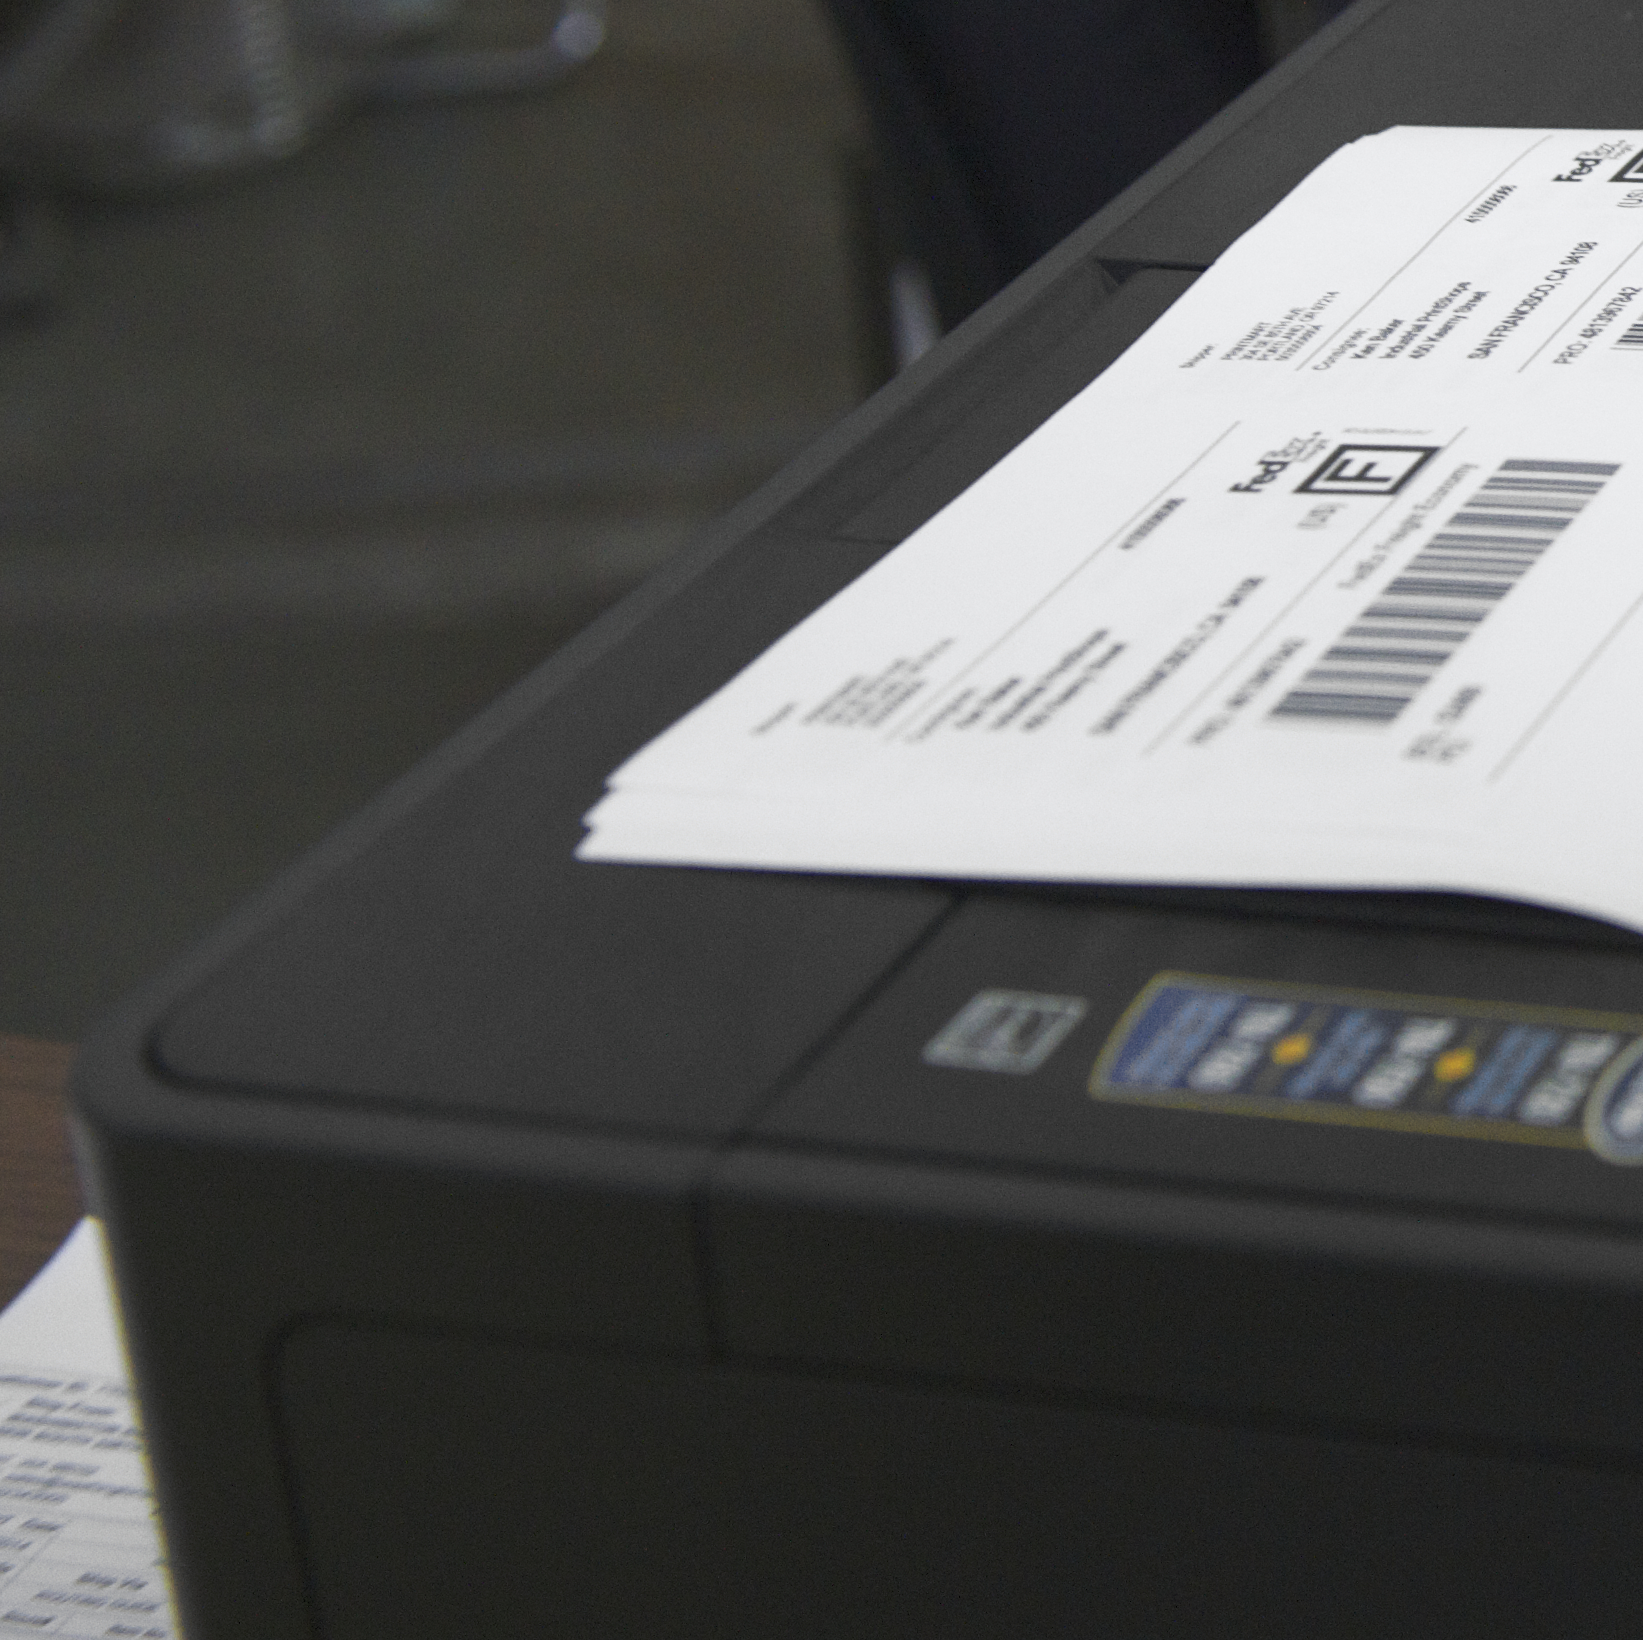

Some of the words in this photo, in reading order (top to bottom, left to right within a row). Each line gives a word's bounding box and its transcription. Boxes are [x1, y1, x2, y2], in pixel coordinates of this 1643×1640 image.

[1467, 339, 1503, 359] SAN
[1488, 283, 1561, 338] FRANCISCO,
[1544, 268, 1572, 281] CA
[1560, 242, 1598, 265] 94108
[1553, 341, 1588, 364] PRO:
[1579, 287, 1642, 339] 4813967842
[1329, 458, 1394, 485] F
